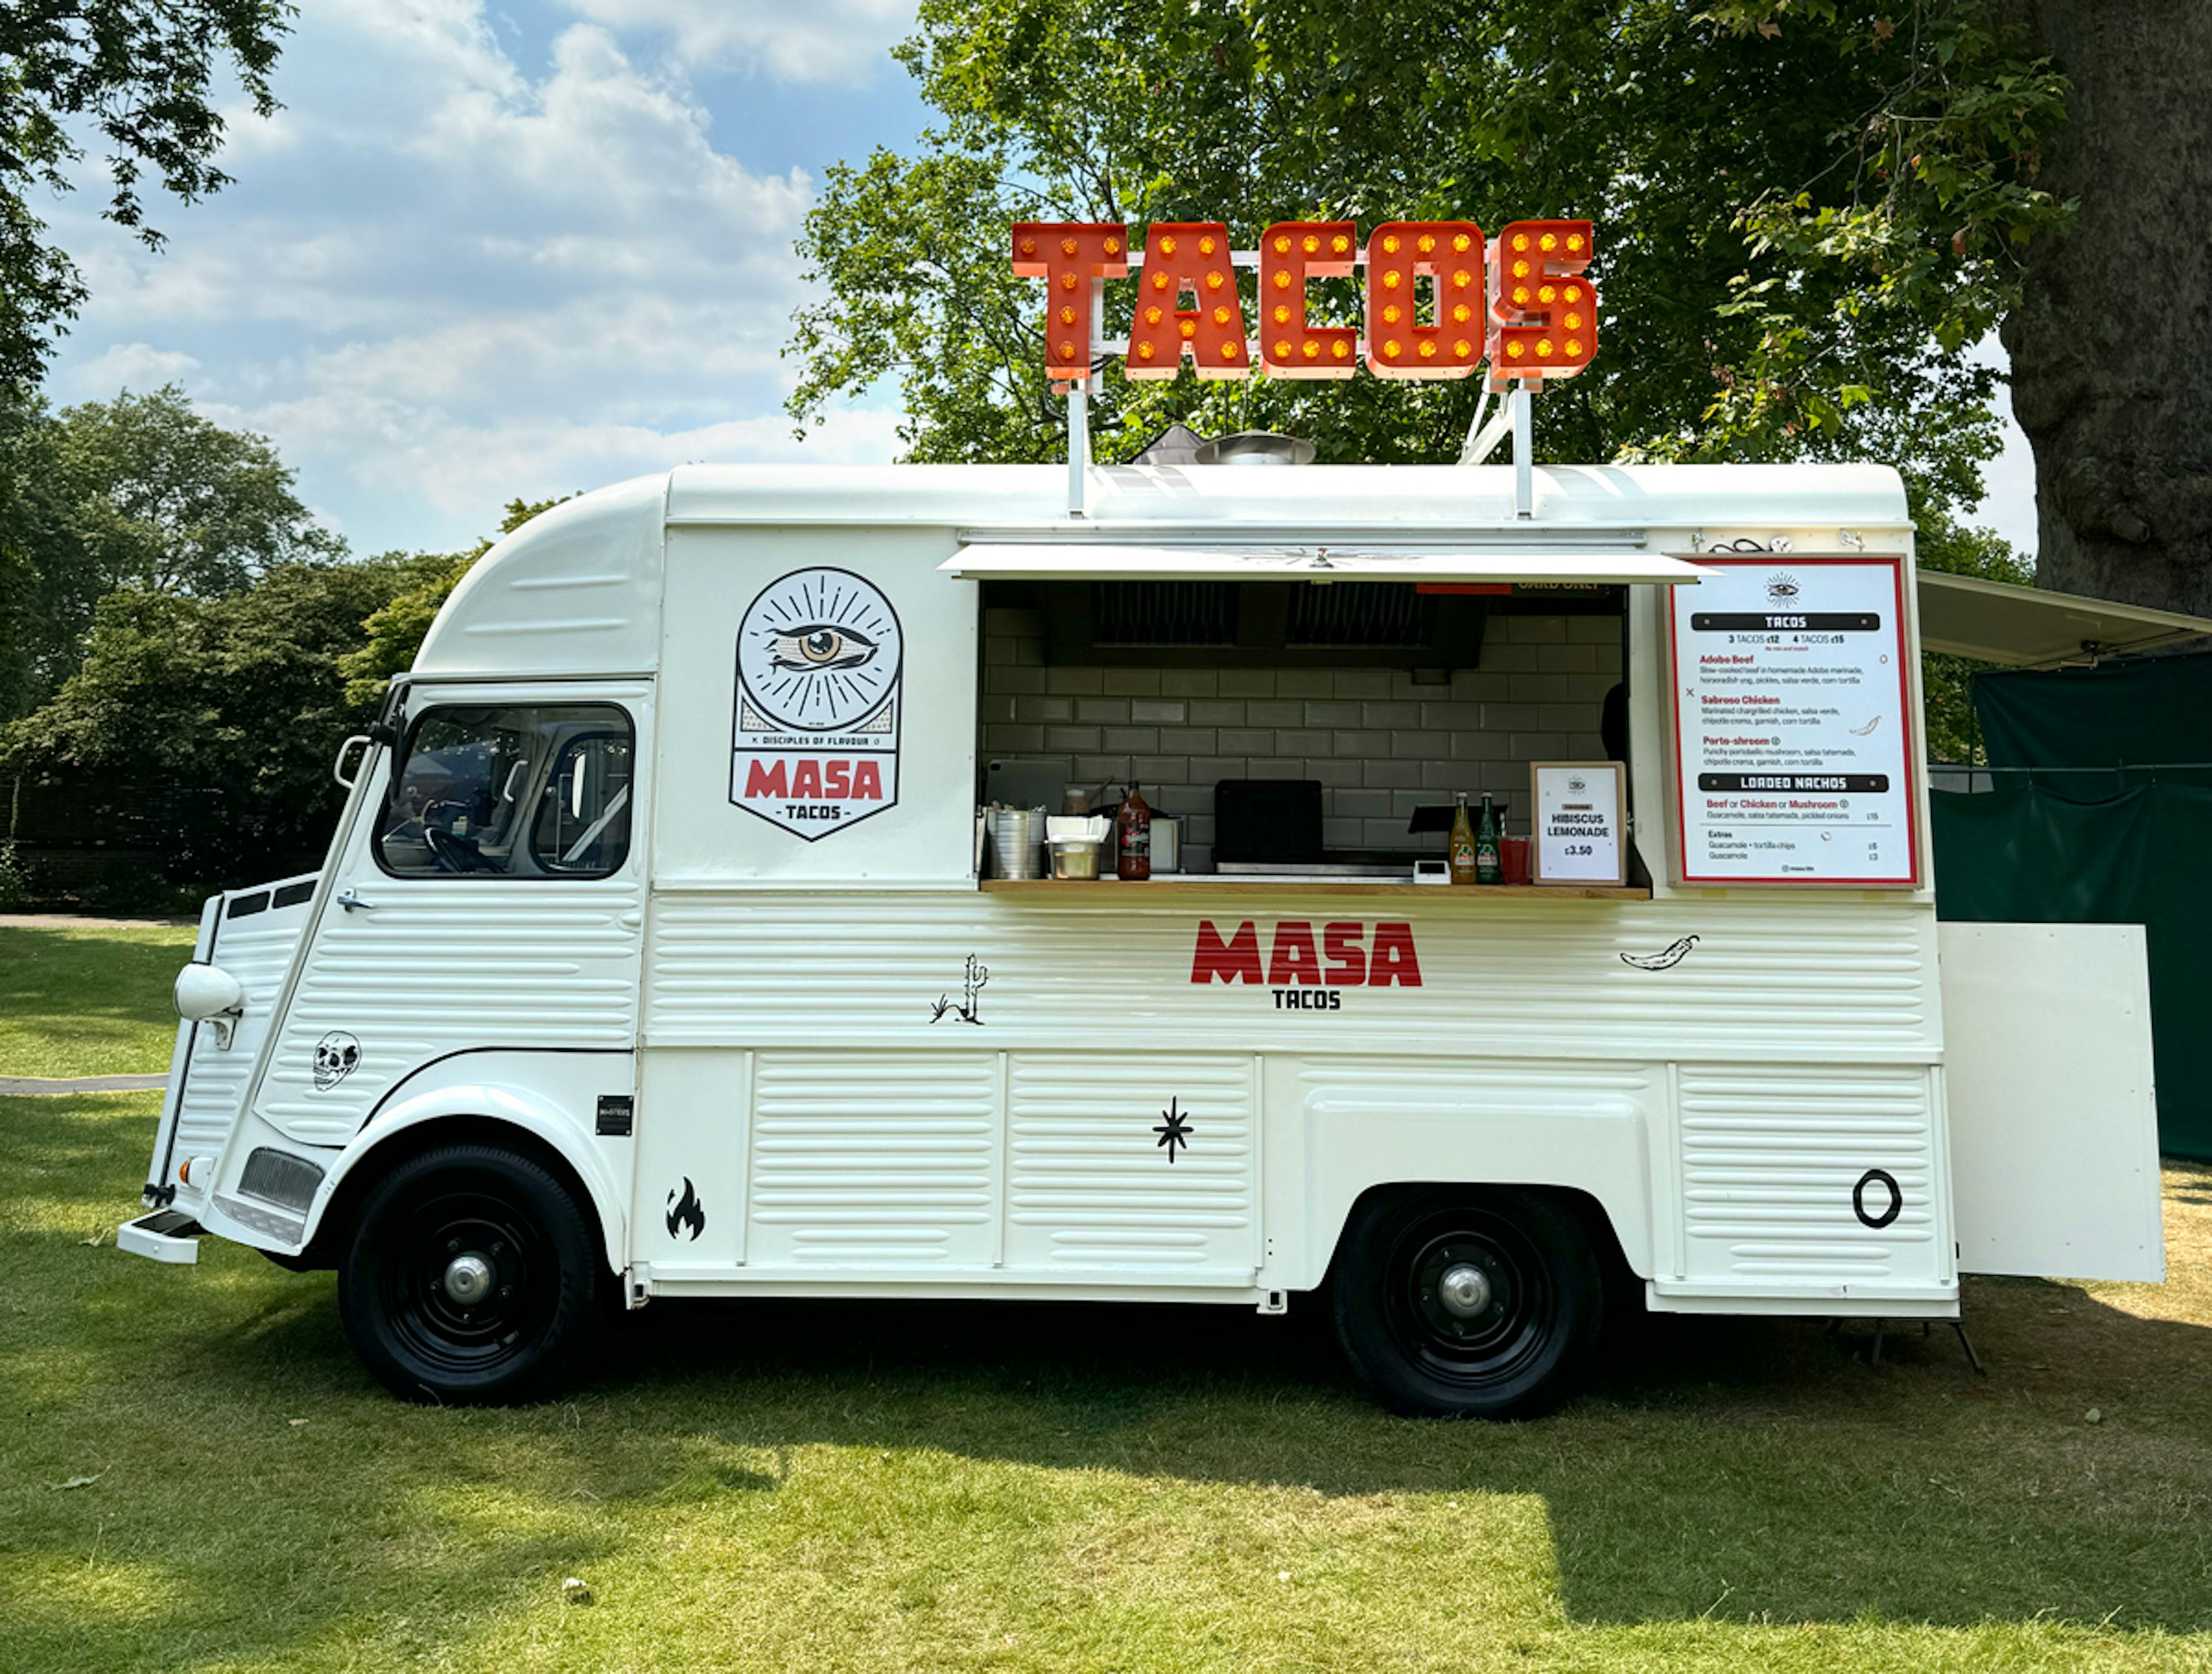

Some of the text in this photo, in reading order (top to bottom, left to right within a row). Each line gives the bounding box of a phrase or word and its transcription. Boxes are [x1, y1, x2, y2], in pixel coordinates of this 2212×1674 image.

[1012, 220, 1597, 380] TACOS
[1765, 616, 1806, 628] TACOS
[1729, 634, 1734, 644] 3
[1737, 634, 1764, 644] TACOS
[1766, 634, 1779, 644] £12
[1793, 634, 1799, 644] 4
[1801, 634, 1829, 644] TACOS
[1700, 655, 1753, 664] Adobo Beef
[1702, 695, 1781, 705] Sabroso Chicken
[1772, 707, 1800, 715] chicken,
[1702, 717, 1729, 725] chipotle
[1755, 718, 1781, 726] garnish,
[763, 736, 869, 746] DISCIPLES OF FLAVOUR
[1703, 736, 1769, 745] Porto-shroom
[1703, 747, 1727, 755] Punchy
[1703, 758, 1731, 766] chipotle
[1756, 759, 1783, 767] garnish,
[744, 759, 883, 800] MASA
[1741, 777, 1847, 789] LOADED NACHOS
[1707, 799, 1727, 808] Beef
[1740, 799, 1777, 808] Chicken
[1789, 800, 1838, 809] Mushroom
[785, 805, 841, 819] TACOS
[1707, 811, 1747, 819] Guacamole,
[1748, 811, 1764, 819] salsa
[1801, 812, 1825, 820] pickled
[1552, 813, 1604, 823] HIBISCUS
[1547, 826, 1609, 837] LEMONADE
[1708, 830, 1732, 838] Extras
[1565, 844, 1593, 855] £3.50
[1709, 840, 1747, 849] Guacamole
[1753, 840, 1775, 849] tortilla
[1777, 842, 1796, 850] chips
[1709, 851, 1748, 859] Guacamole
[1191, 920, 1423, 986] MASA
[1272, 990, 1341, 1009] TACOS
